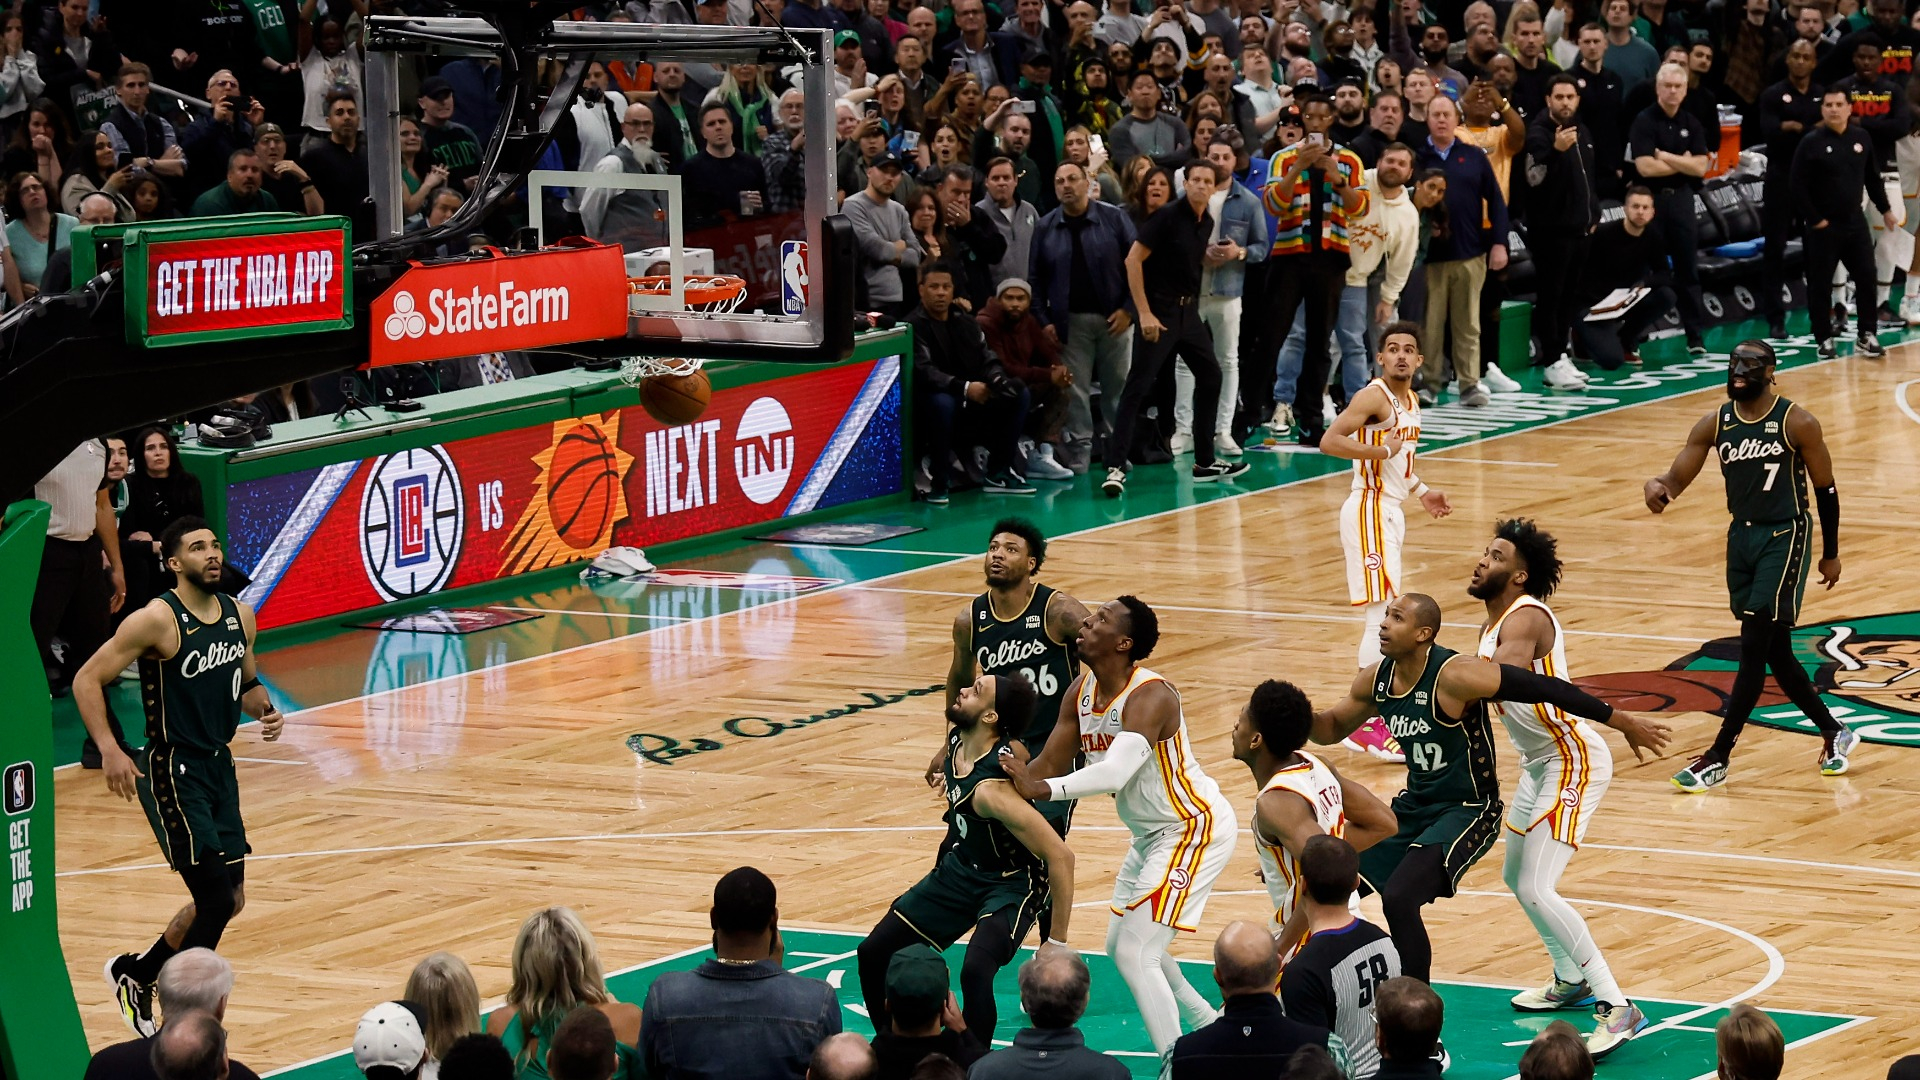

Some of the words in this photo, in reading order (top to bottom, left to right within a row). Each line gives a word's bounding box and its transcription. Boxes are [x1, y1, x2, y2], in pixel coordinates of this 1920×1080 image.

[157, 260, 197, 316] GET
[201, 256, 242, 312] THE
[246, 253, 288, 309] NBA
[292, 250, 333, 305] APP
[1724, 413, 1731, 422] 6
[1719, 438, 1785, 464] Celtics
[645, 418, 721, 518] NEXT
[1762, 463, 1781, 491] 7
[478, 479, 504, 532] VS
[181, 613, 189, 623] 6
[979, 610, 987, 620] 6
[181, 640, 246, 679] Celtics
[977, 639, 1048, 672] Celtics
[232, 667, 242, 702] 0
[1377, 681, 1385, 692] 6
[1384, 714, 1432, 738] ltics
[1412, 742, 1449, 771] 42
[9, 818, 31, 851] GET
[10, 848, 32, 882] THE
[12, 879, 34, 913] APP
[1354, 953, 1390, 1009] 58
